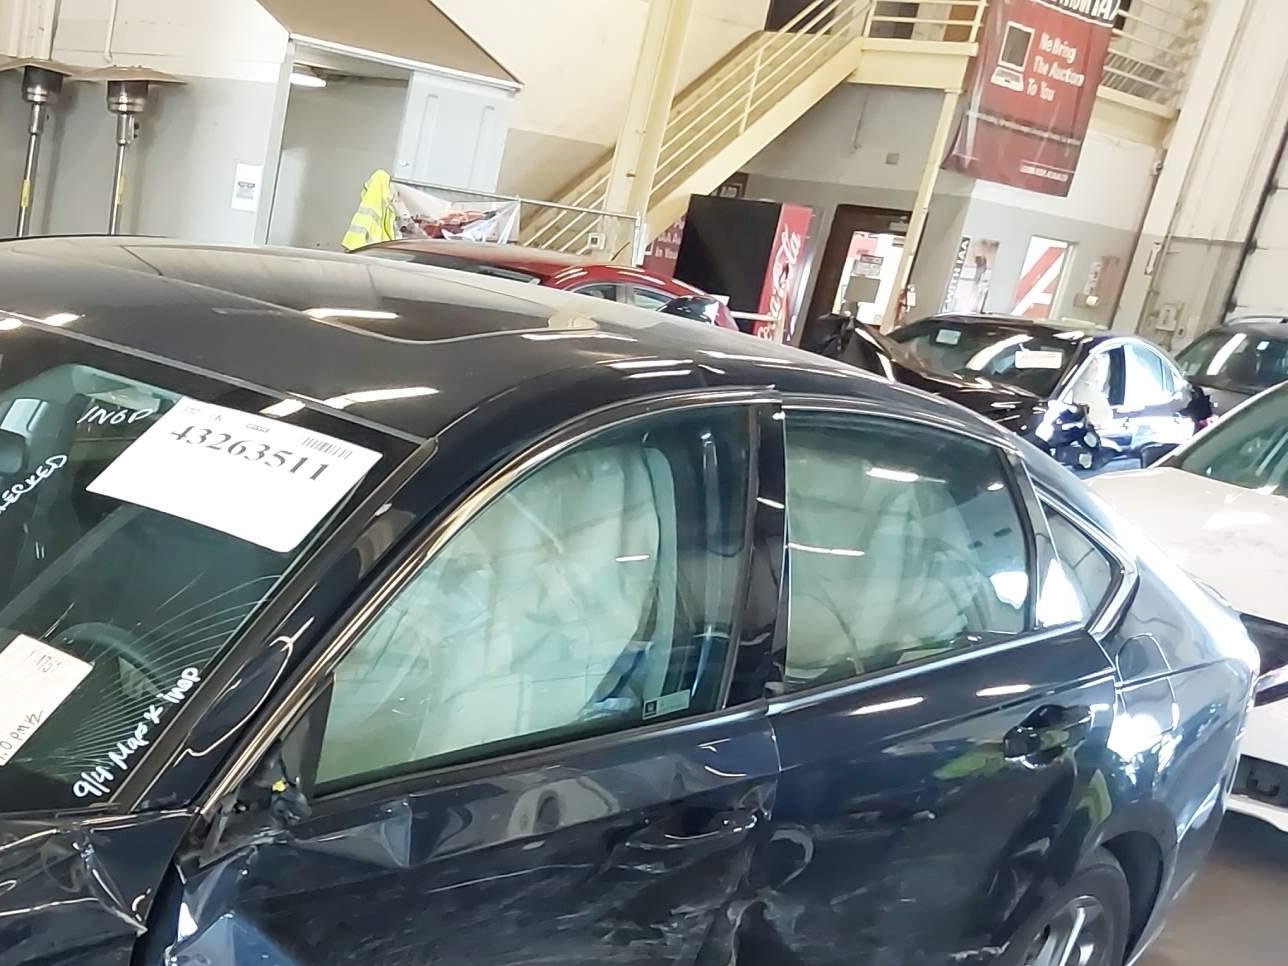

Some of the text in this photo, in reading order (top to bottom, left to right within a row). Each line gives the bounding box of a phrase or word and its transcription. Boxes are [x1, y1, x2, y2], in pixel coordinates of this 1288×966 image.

[1052, 38, 1077, 64] Bring
[1033, 55, 1049, 76] The
[1027, 78, 1055, 101] To You
[169, 424, 330, 481] 43263511
